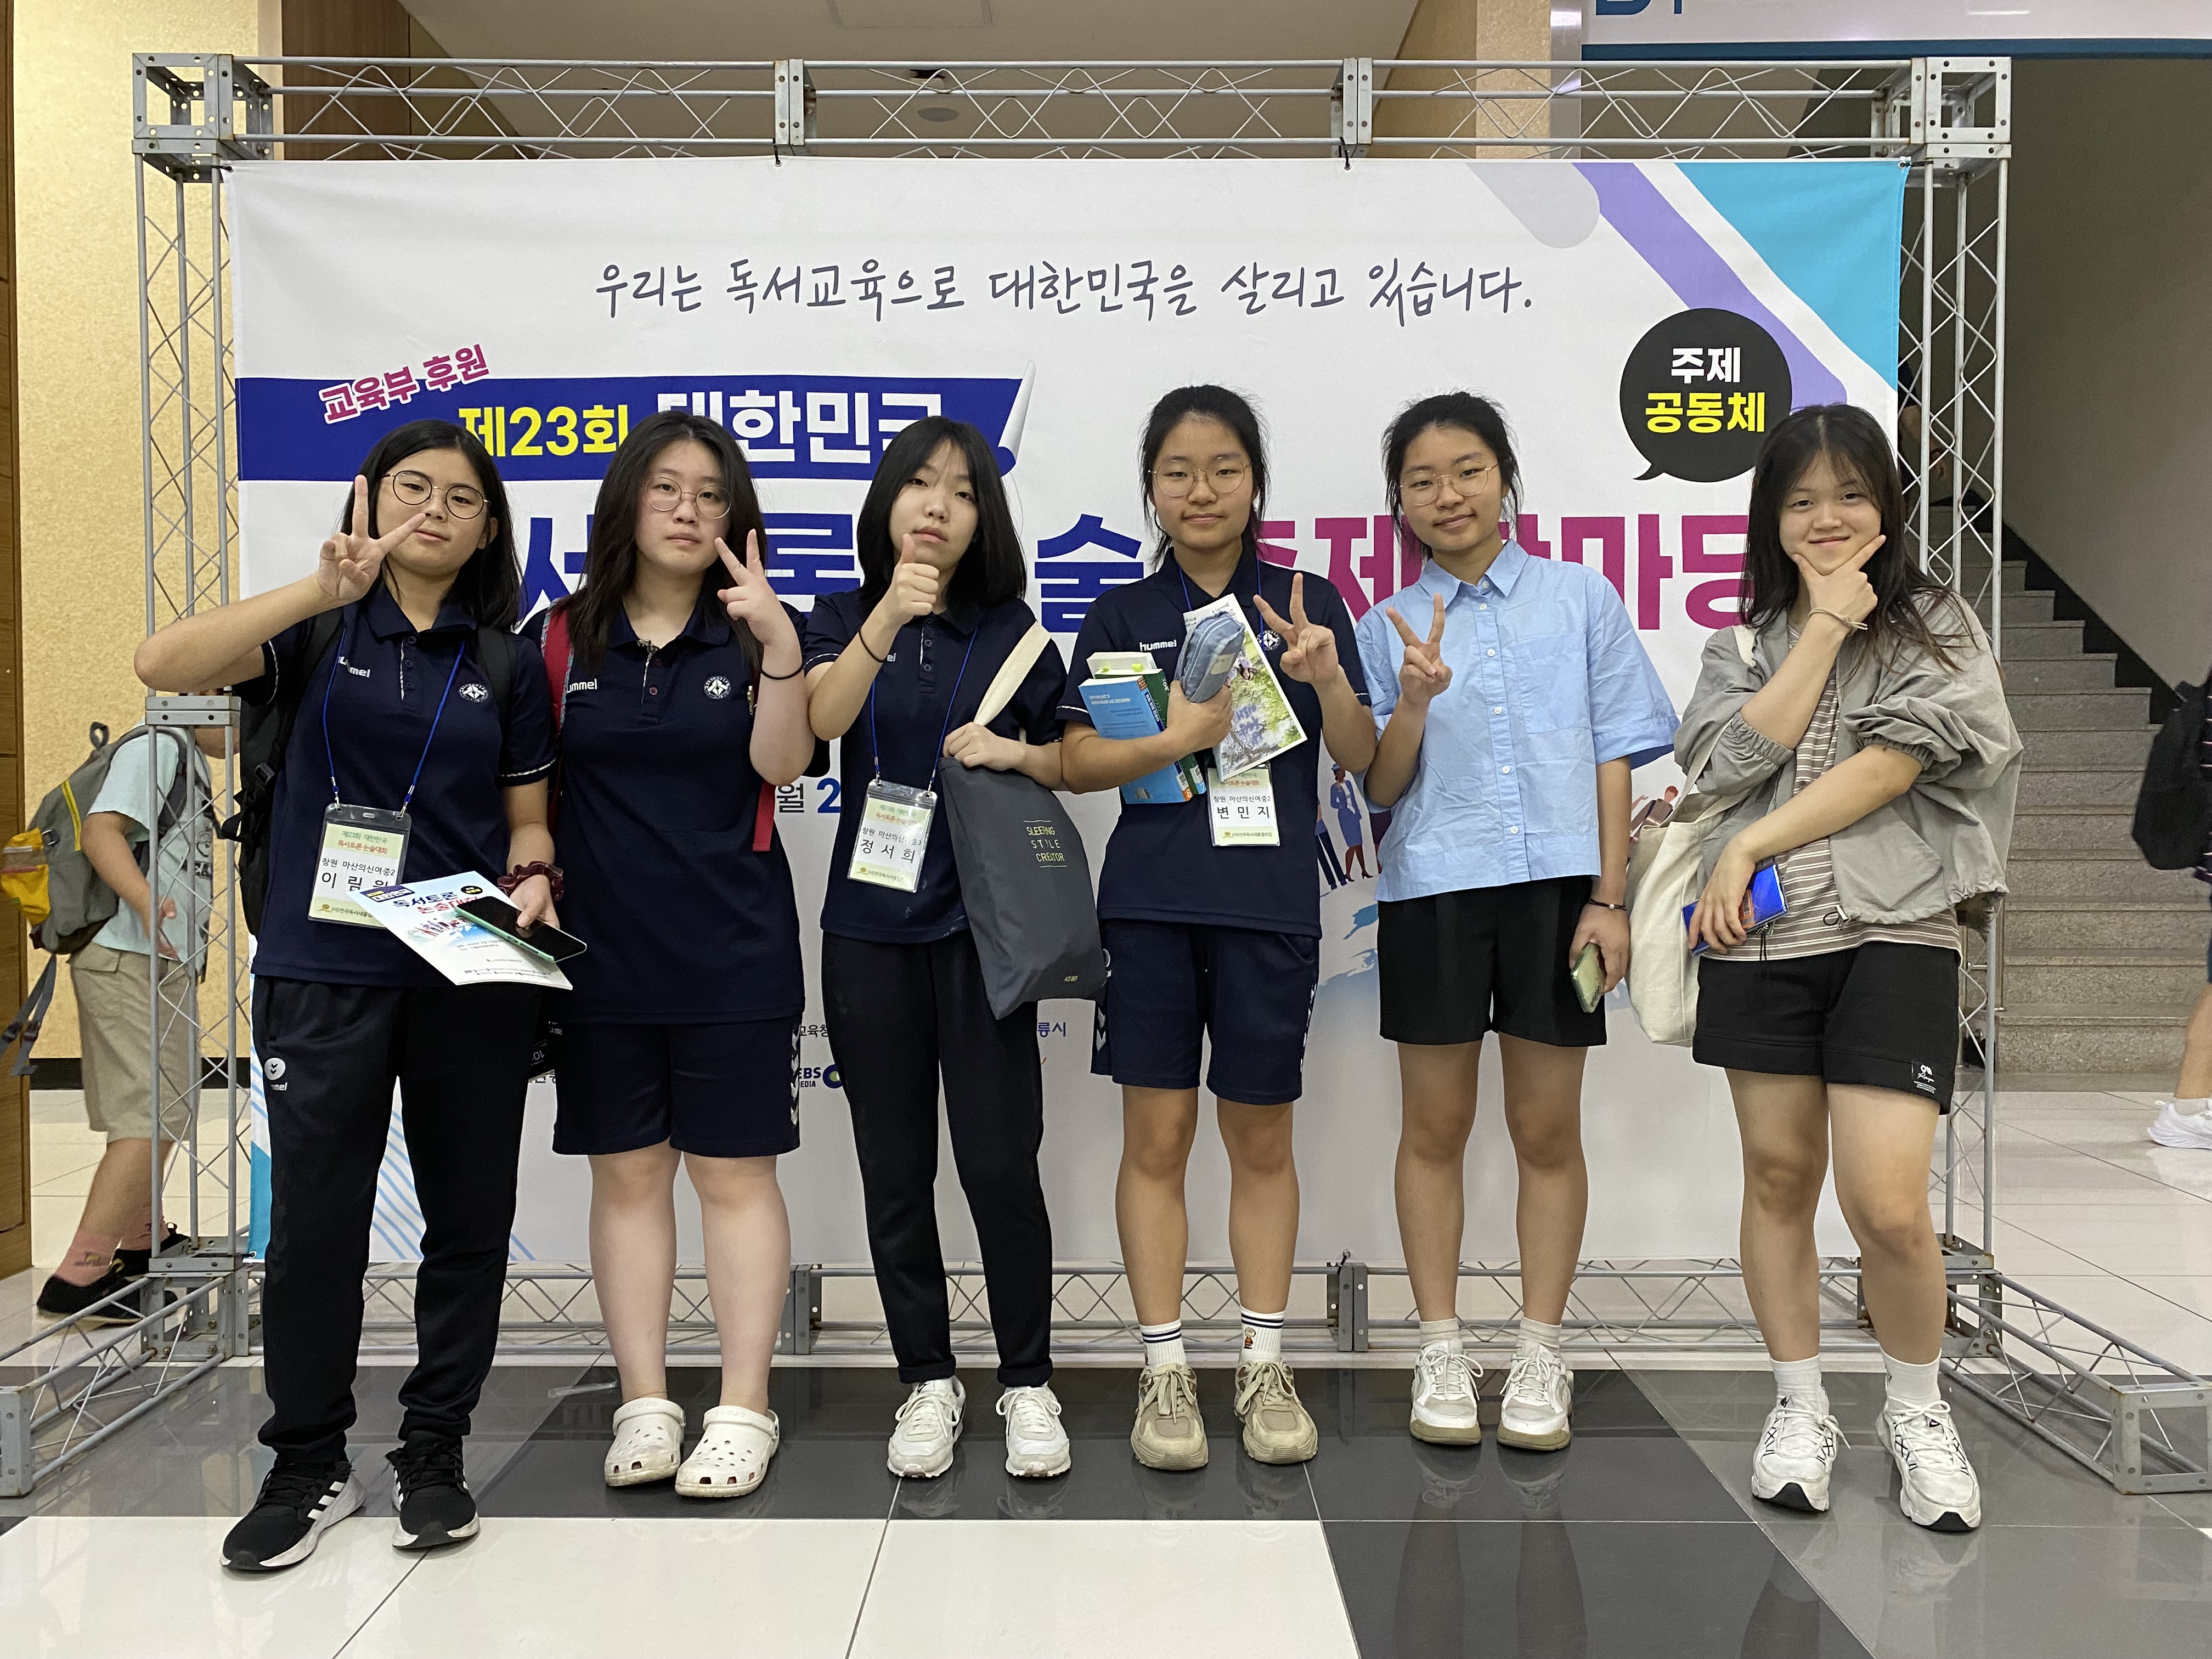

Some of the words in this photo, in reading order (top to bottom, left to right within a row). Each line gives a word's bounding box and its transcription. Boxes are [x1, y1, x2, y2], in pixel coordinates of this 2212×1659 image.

[596, 264, 702, 319] 우리는
[726, 259, 966, 323] 독서교육으로
[988, 260, 1198, 322] 대한민국을
[1220, 261, 1345, 316] 살리고
[1368, 257, 1533, 328] 있습니다.
[320, 365, 419, 422] 교육부
[422, 343, 491, 389] 후원
[1671, 347, 1741, 384] 주제
[459, 404, 629, 457] 제23회
[1646, 392, 1765, 433] 공동체
[1139, 639, 1177, 652] hummel
[567, 678, 597, 693] ummel
[321, 857, 338, 868] 창원
